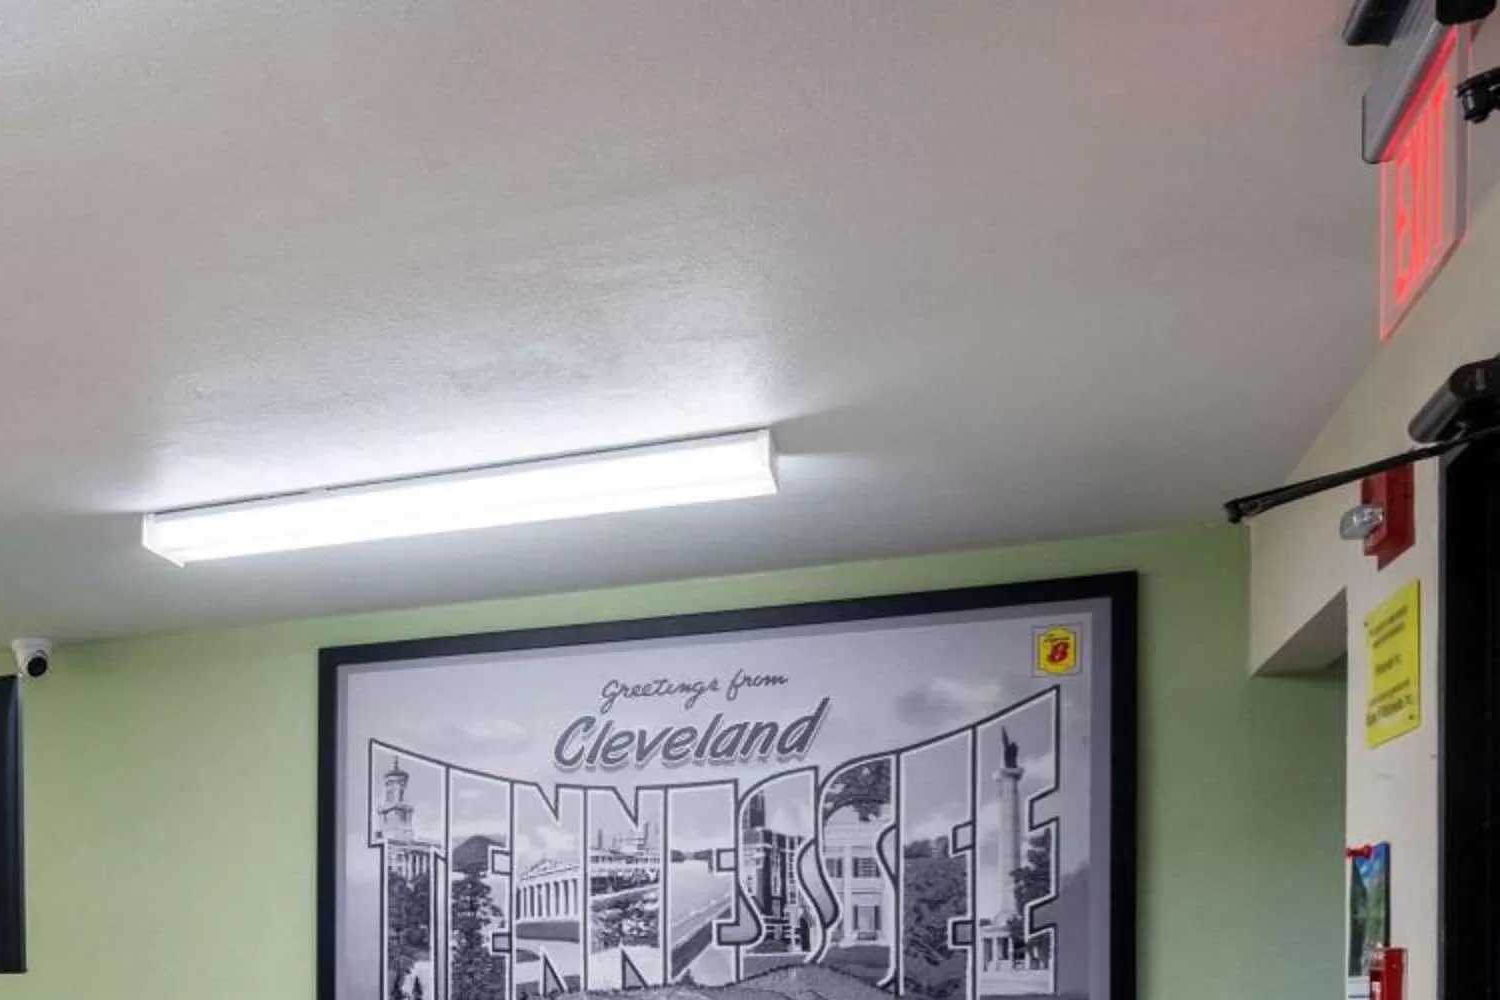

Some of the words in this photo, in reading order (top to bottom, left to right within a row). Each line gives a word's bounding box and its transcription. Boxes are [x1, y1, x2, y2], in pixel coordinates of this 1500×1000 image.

[600, 679, 721, 714] Greetings
[726, 668, 789, 701] from
[554, 697, 831, 772] Cleveland
